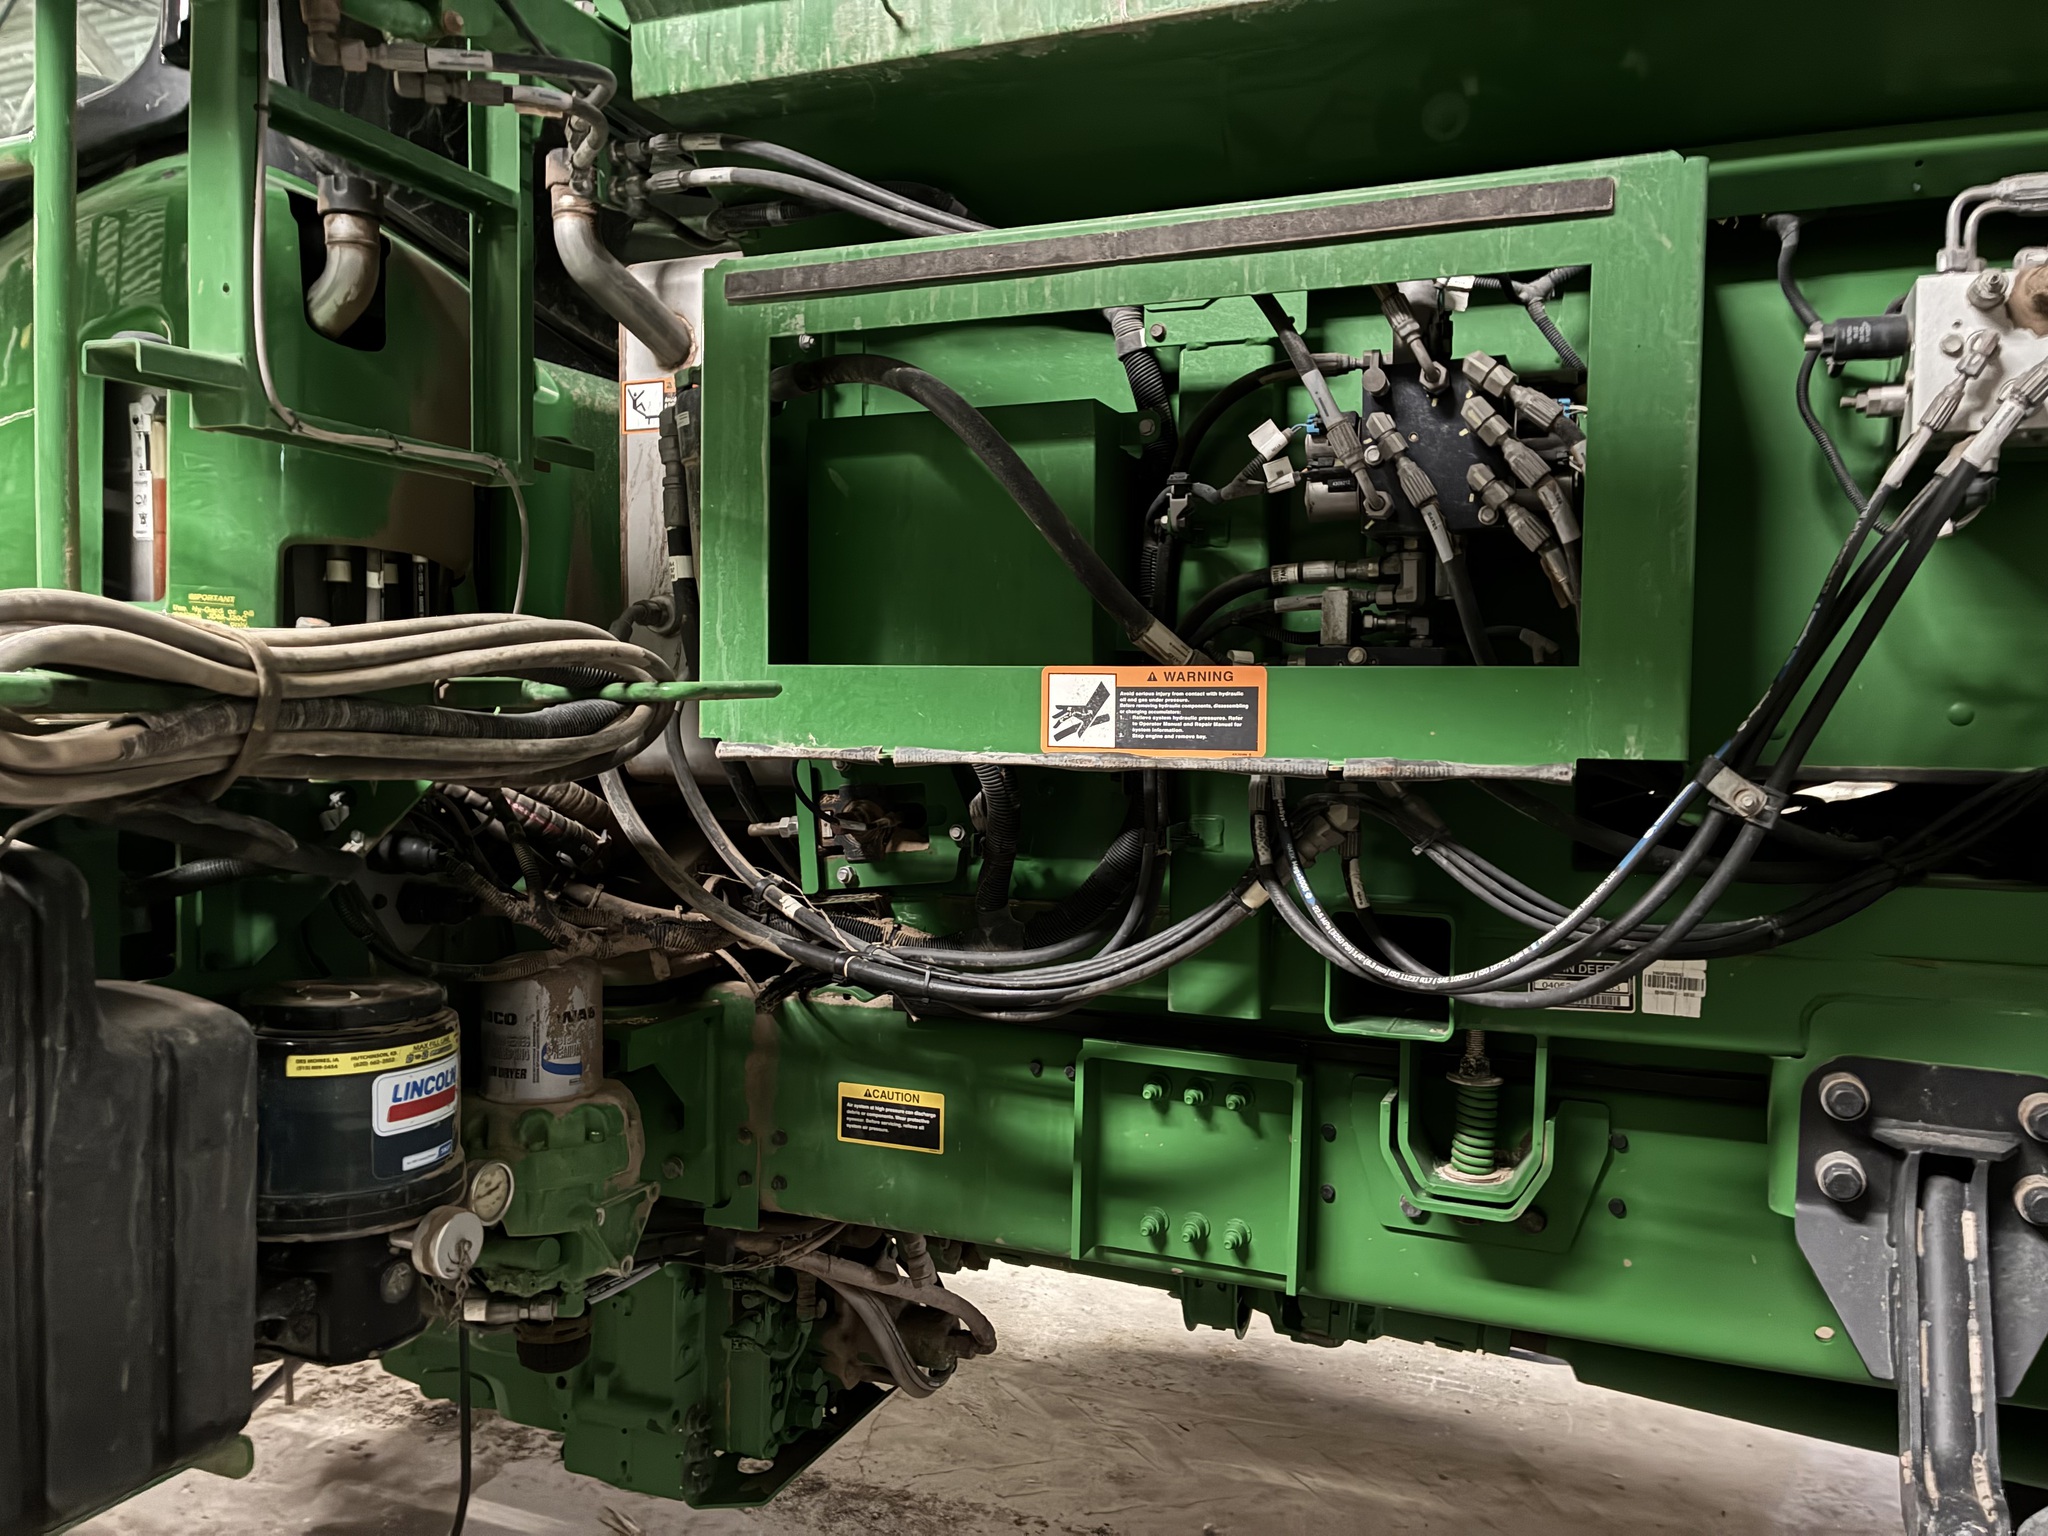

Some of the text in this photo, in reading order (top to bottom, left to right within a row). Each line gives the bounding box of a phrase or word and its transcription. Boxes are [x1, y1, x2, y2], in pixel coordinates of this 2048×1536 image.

[1164, 671, 1234, 682] WARNING
[1312, 904, 1324, 919] 22.5
[1320, 916, 1332, 930] MPa
[1328, 927, 1345, 945] (3250
[1341, 941, 1355, 954] PSI)
[1399, 973, 1420, 983] 11237
[413, 1043, 429, 1051] MAX
[391, 1064, 457, 1103] LINCOLN
[872, 1089, 920, 1104] CAUTION
[914, 1110, 937, 1119] discharge
[907, 1117, 930, 1125] protective
